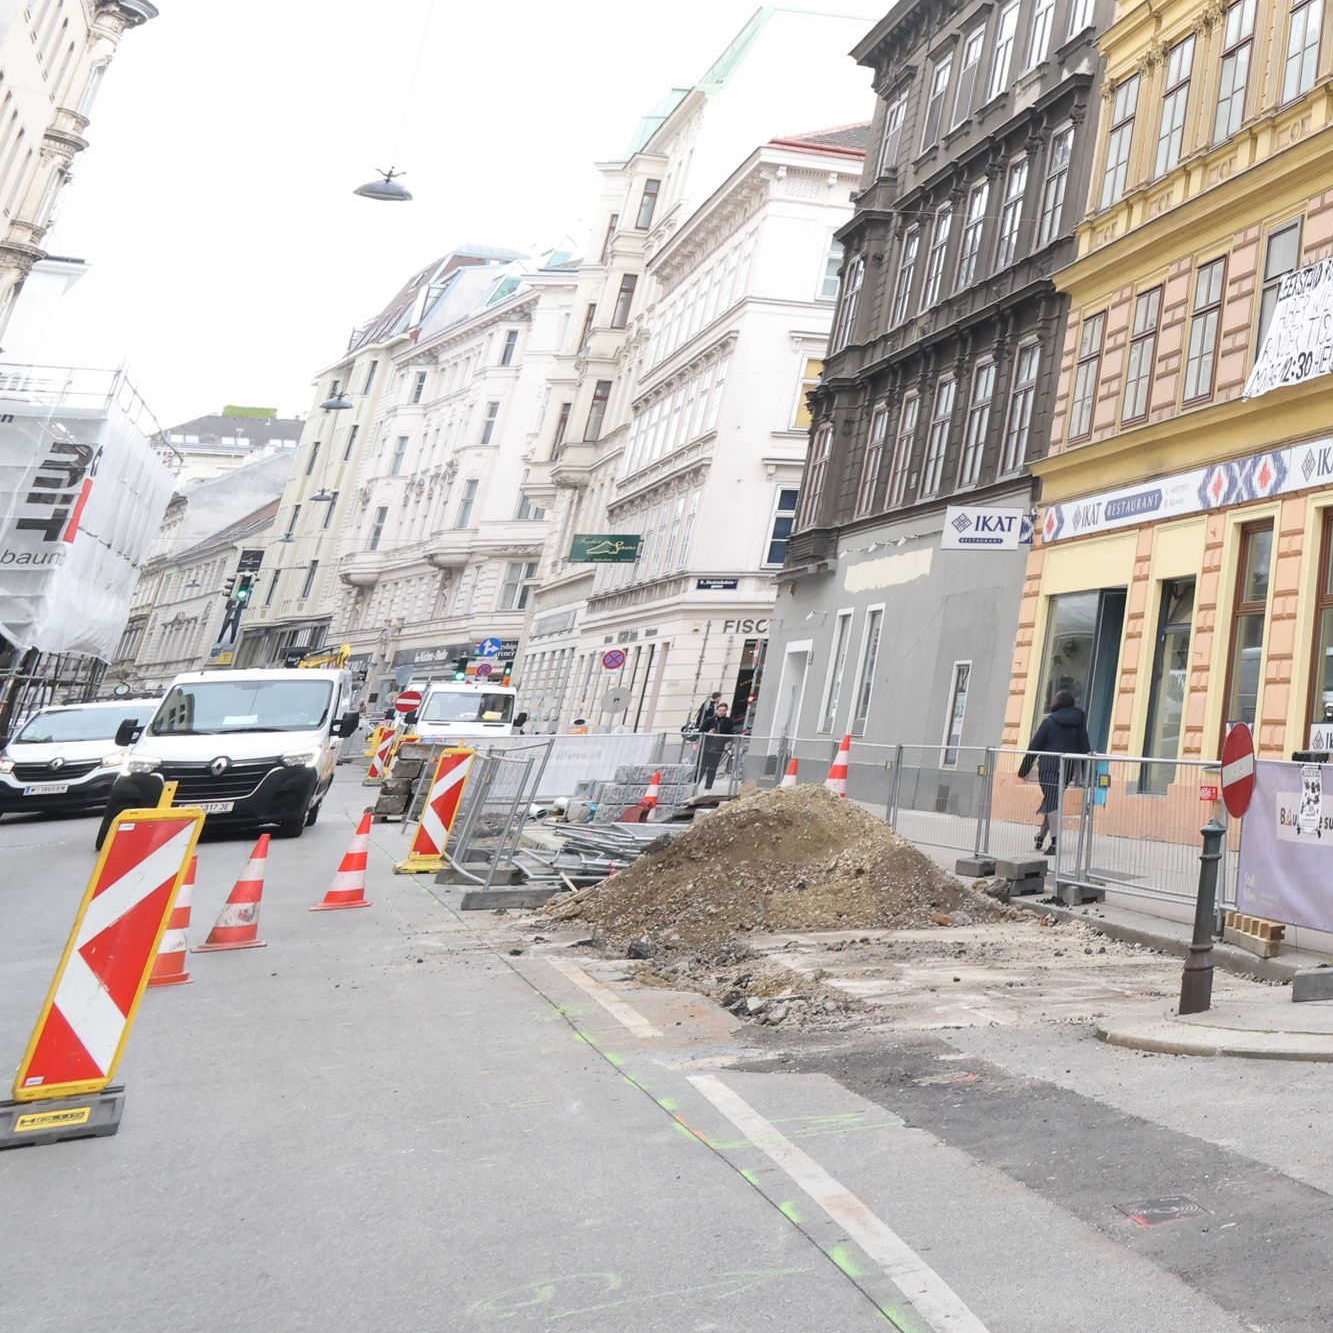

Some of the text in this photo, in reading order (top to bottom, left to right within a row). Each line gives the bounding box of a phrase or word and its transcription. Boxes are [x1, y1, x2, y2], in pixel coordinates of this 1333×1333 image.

[974, 514, 1017, 533] IKAT
[1080, 492, 1160, 529] IKAT RESTAURANT
